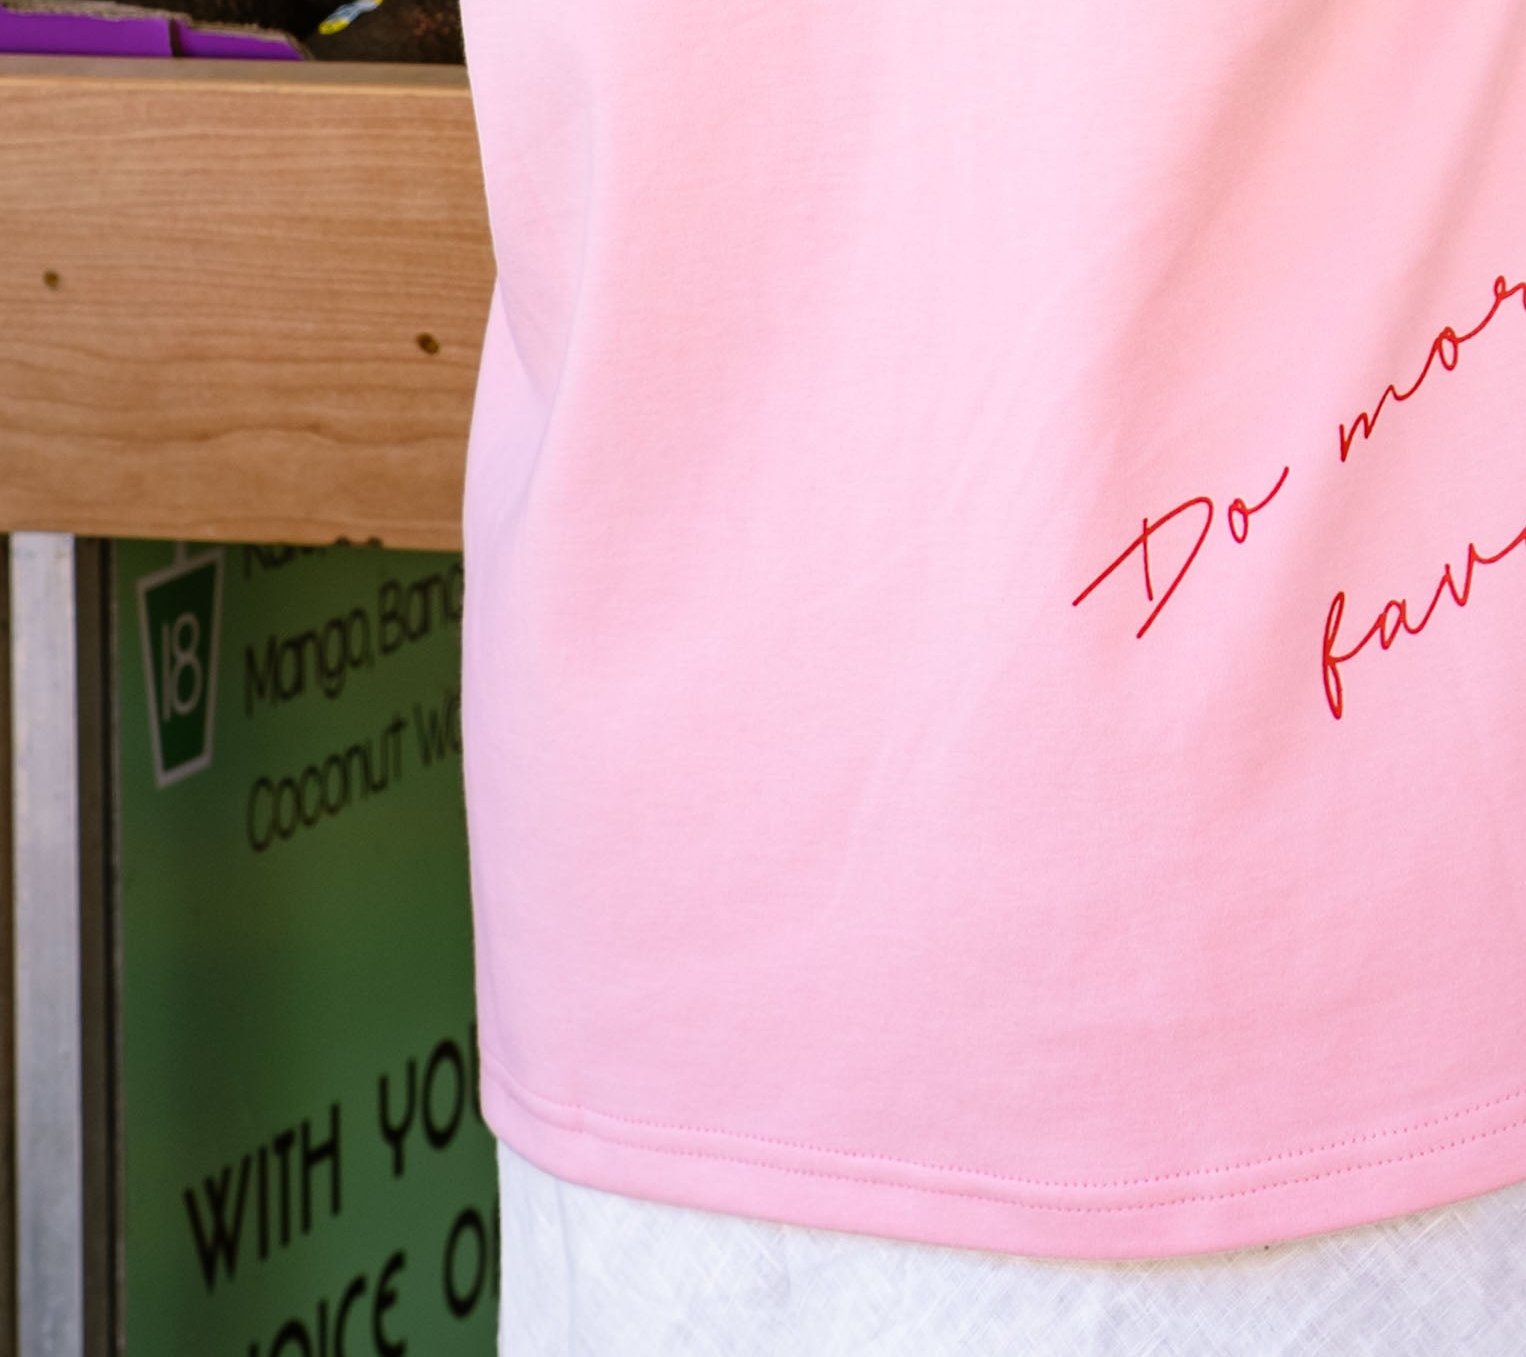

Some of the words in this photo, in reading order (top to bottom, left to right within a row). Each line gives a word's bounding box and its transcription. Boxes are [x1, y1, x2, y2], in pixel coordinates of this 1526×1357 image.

[1073, 468, 1289, 639] Do
[161, 612, 202, 723] 18
[247, 714, 408, 854] Coconut
[183, 1100, 341, 1295] WITH
